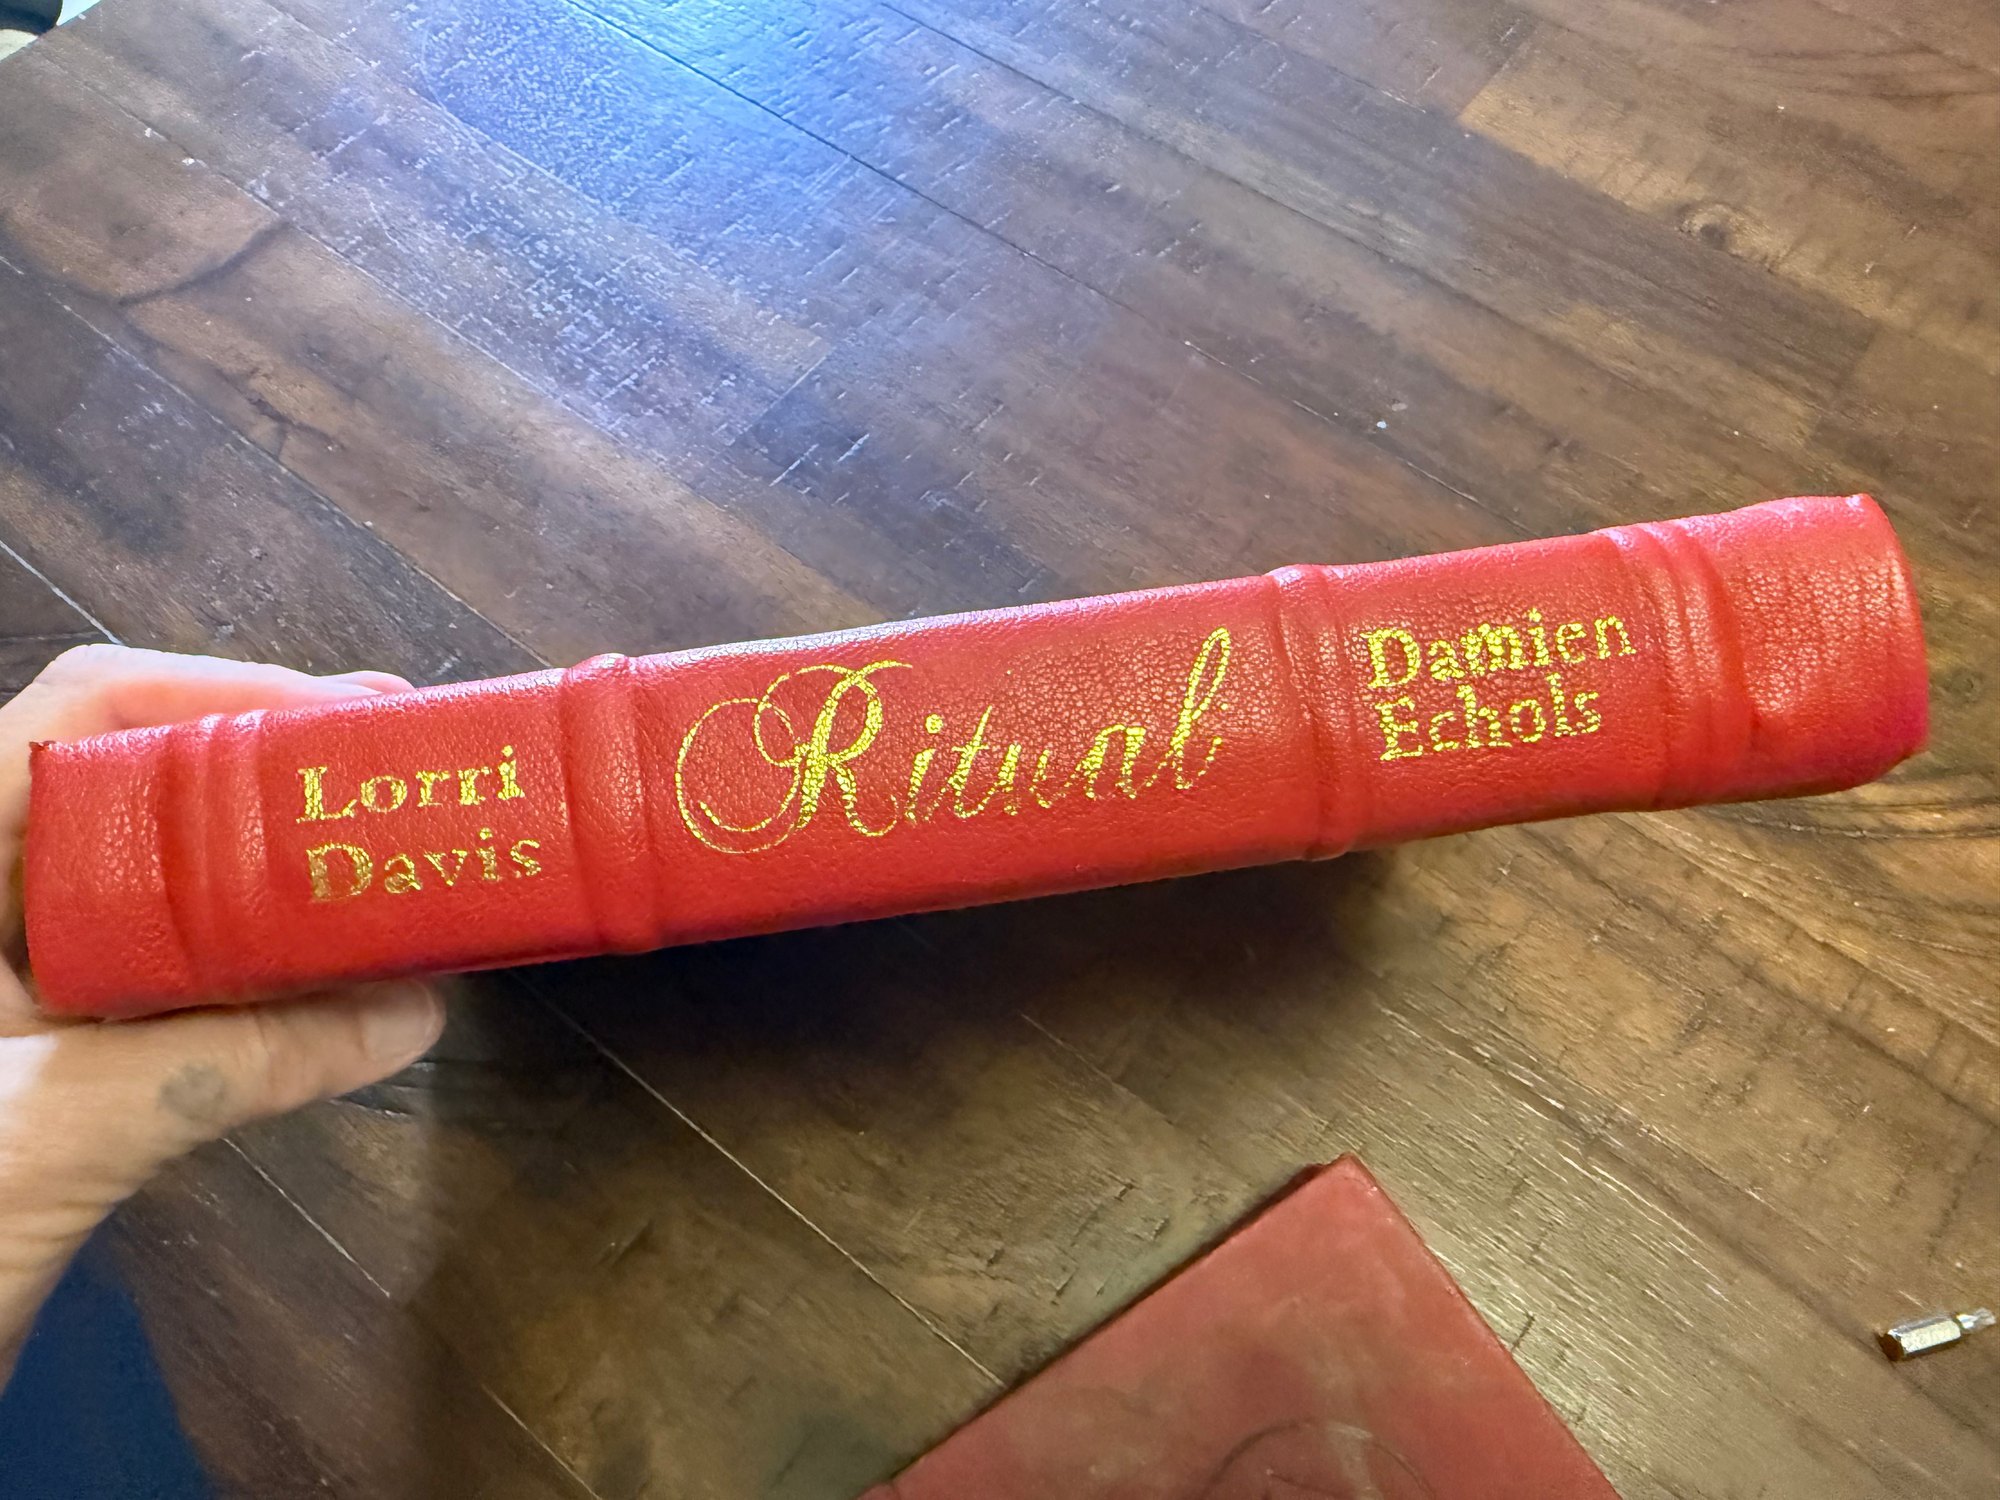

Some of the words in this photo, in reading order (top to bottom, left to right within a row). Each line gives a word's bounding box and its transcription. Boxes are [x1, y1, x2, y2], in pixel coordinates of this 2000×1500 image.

[1360, 607, 1636, 689] Damien
[675, 627, 1231, 855] Ritual
[1374, 672, 1601, 761] Echols
[296, 745, 525, 823] Lorri
[306, 827, 542, 903] Davis
